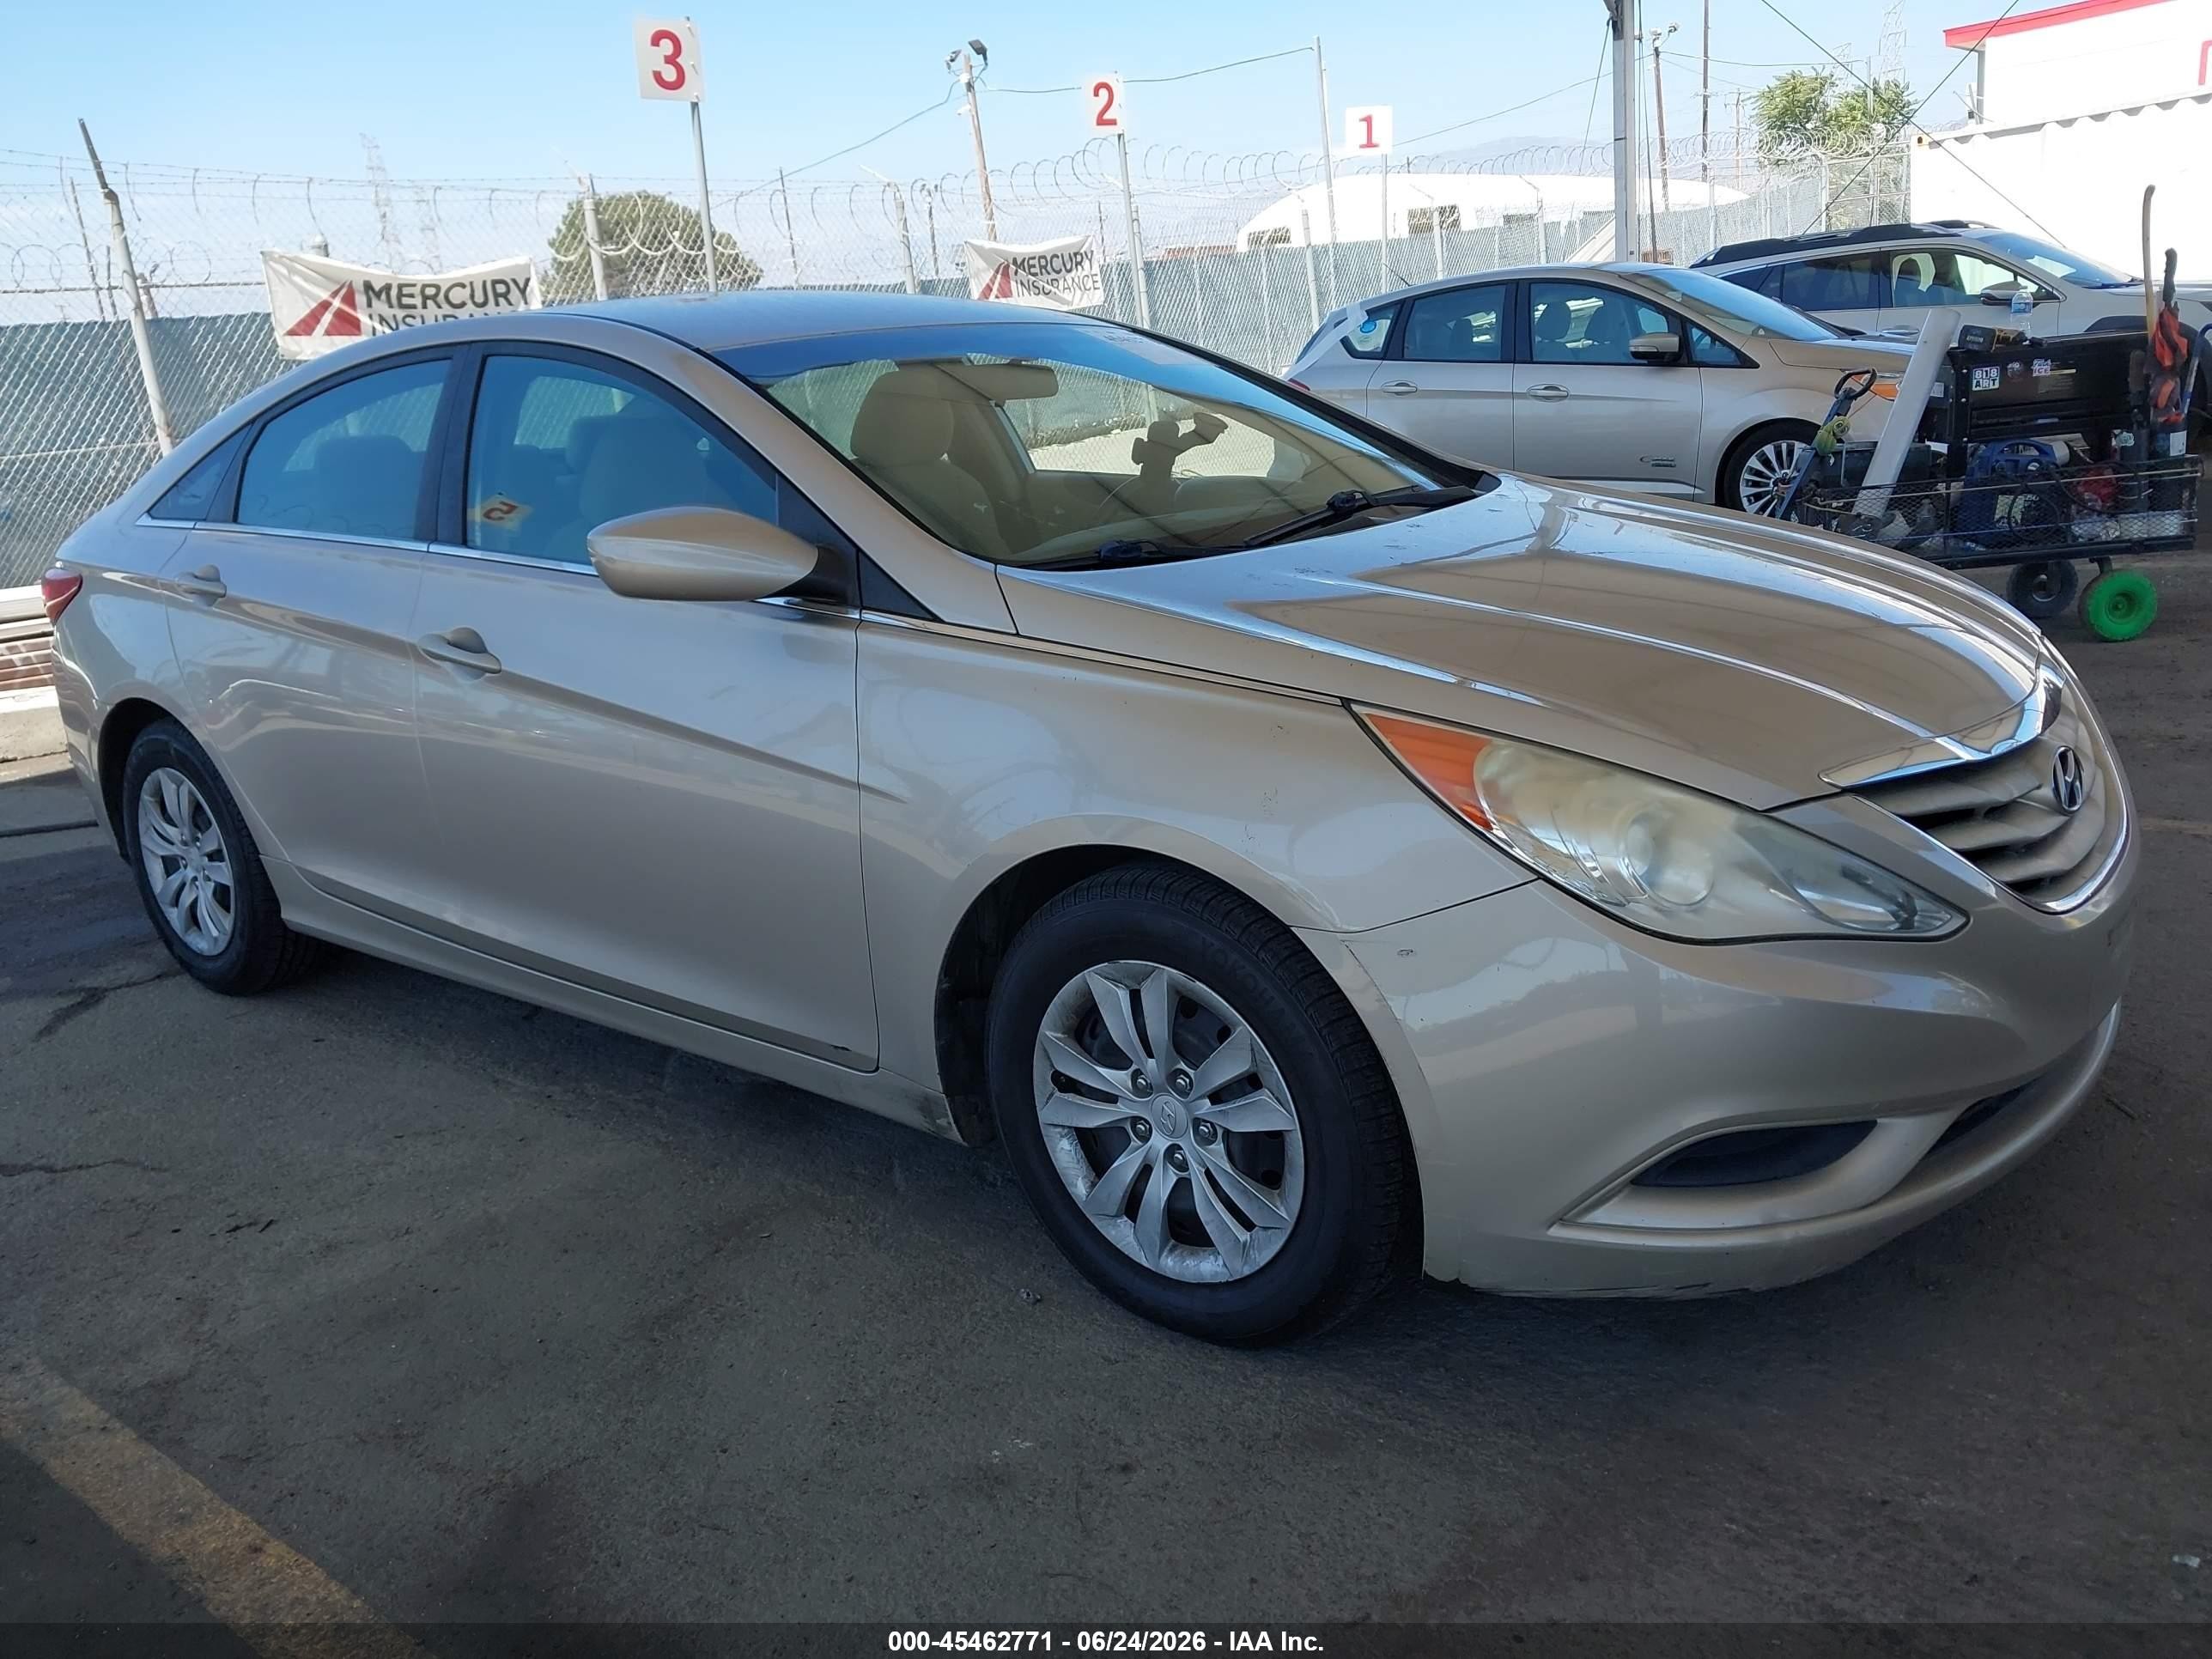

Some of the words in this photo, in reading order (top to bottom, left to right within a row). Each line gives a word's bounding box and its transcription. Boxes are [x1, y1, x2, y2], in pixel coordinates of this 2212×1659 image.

[650, 28, 686, 91] 3
[1092, 81, 1118, 126] 2
[1359, 114, 1380, 149] 1
[1012, 250, 1094, 276] MERCURY
[362, 276, 532, 309] MERCURY
[1015, 273, 1100, 298] INSURANCE
[1974, 378, 1998, 388] ART
[1975, 368, 1998, 379] 818
